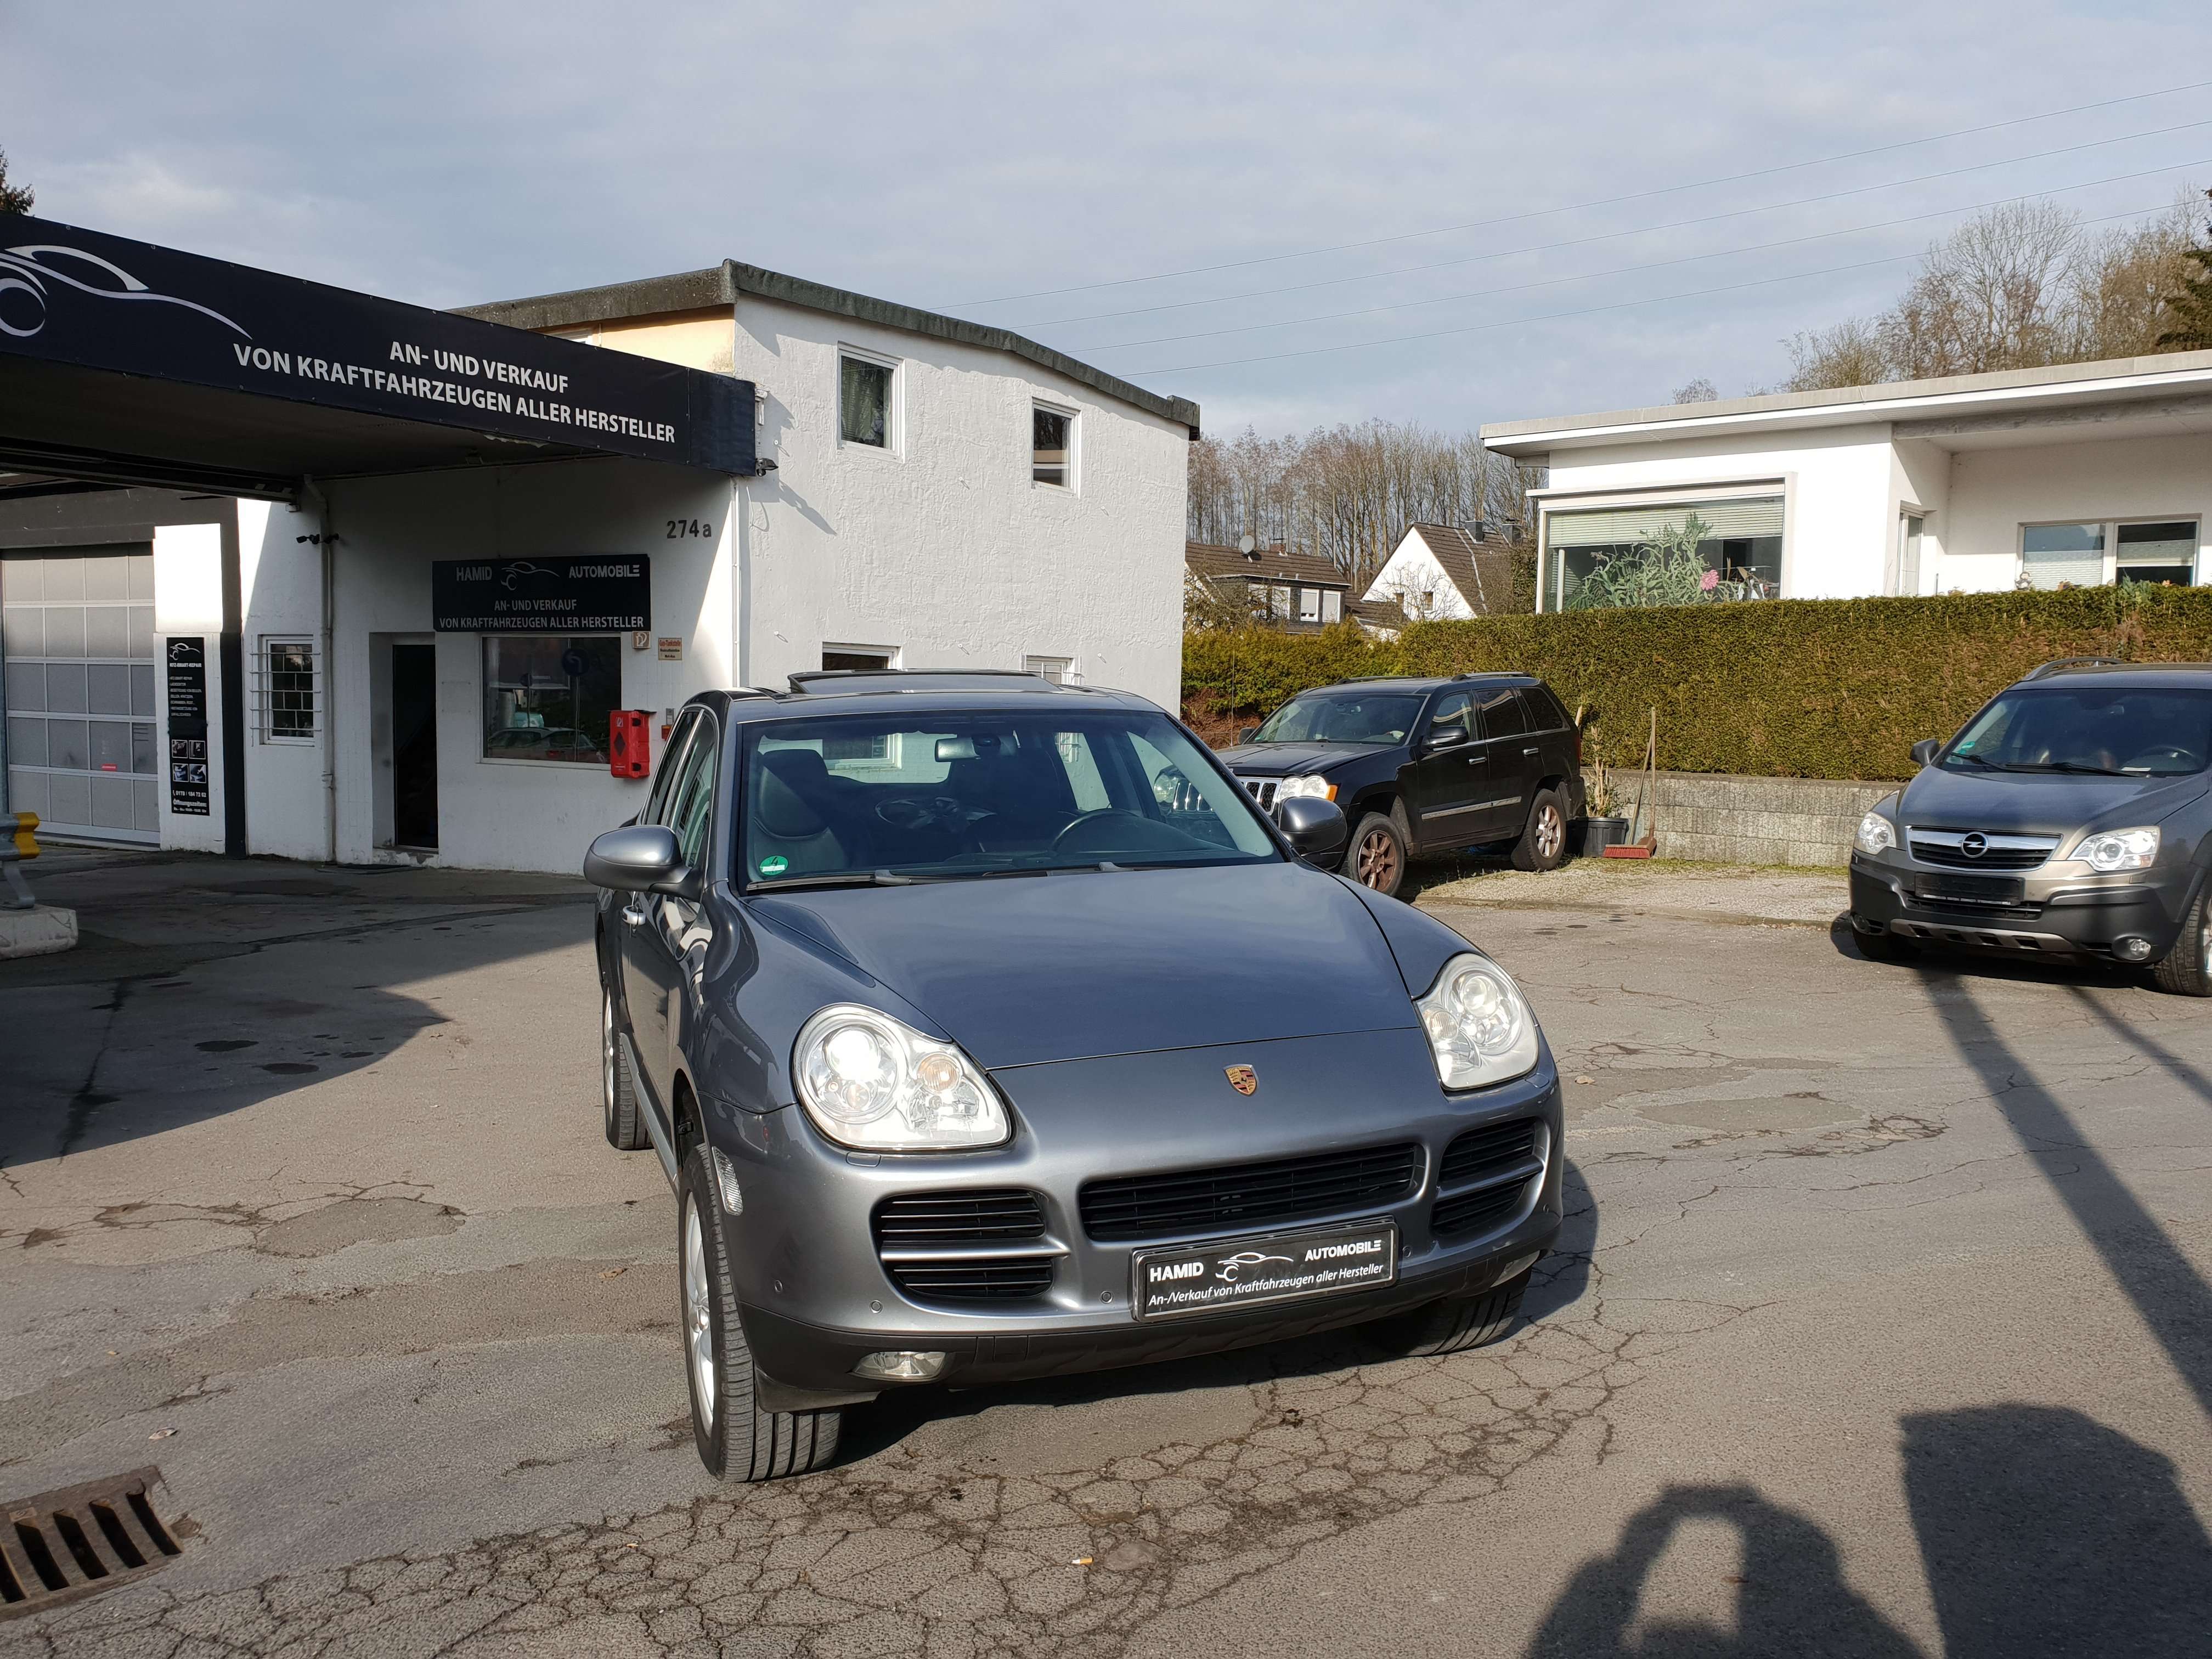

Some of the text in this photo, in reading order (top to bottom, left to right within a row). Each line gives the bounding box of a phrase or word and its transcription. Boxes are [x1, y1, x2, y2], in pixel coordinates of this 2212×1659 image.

[390, 341, 568, 393] AN- UND VERKAUF
[233, 343, 675, 443] VON KRAFTFAHRZEUGEN ALLER HERSTELLER
[667, 519, 712, 539] 274a
[456, 564, 640, 582] HAMID AUTOMOBILE
[494, 599, 577, 611] AN- UND VERKAUF
[439, 616, 644, 628] VON KRAFTFAHRZEUGEN ALLER HERSTELLER
[771, 856, 778, 866] 4
[1149, 1239, 1382, 1283] HAMID AUTOMOBILE
[1148, 1263, 1384, 1307] An-/Verkauf von Kraftfahrzeugen aller Hersteller
